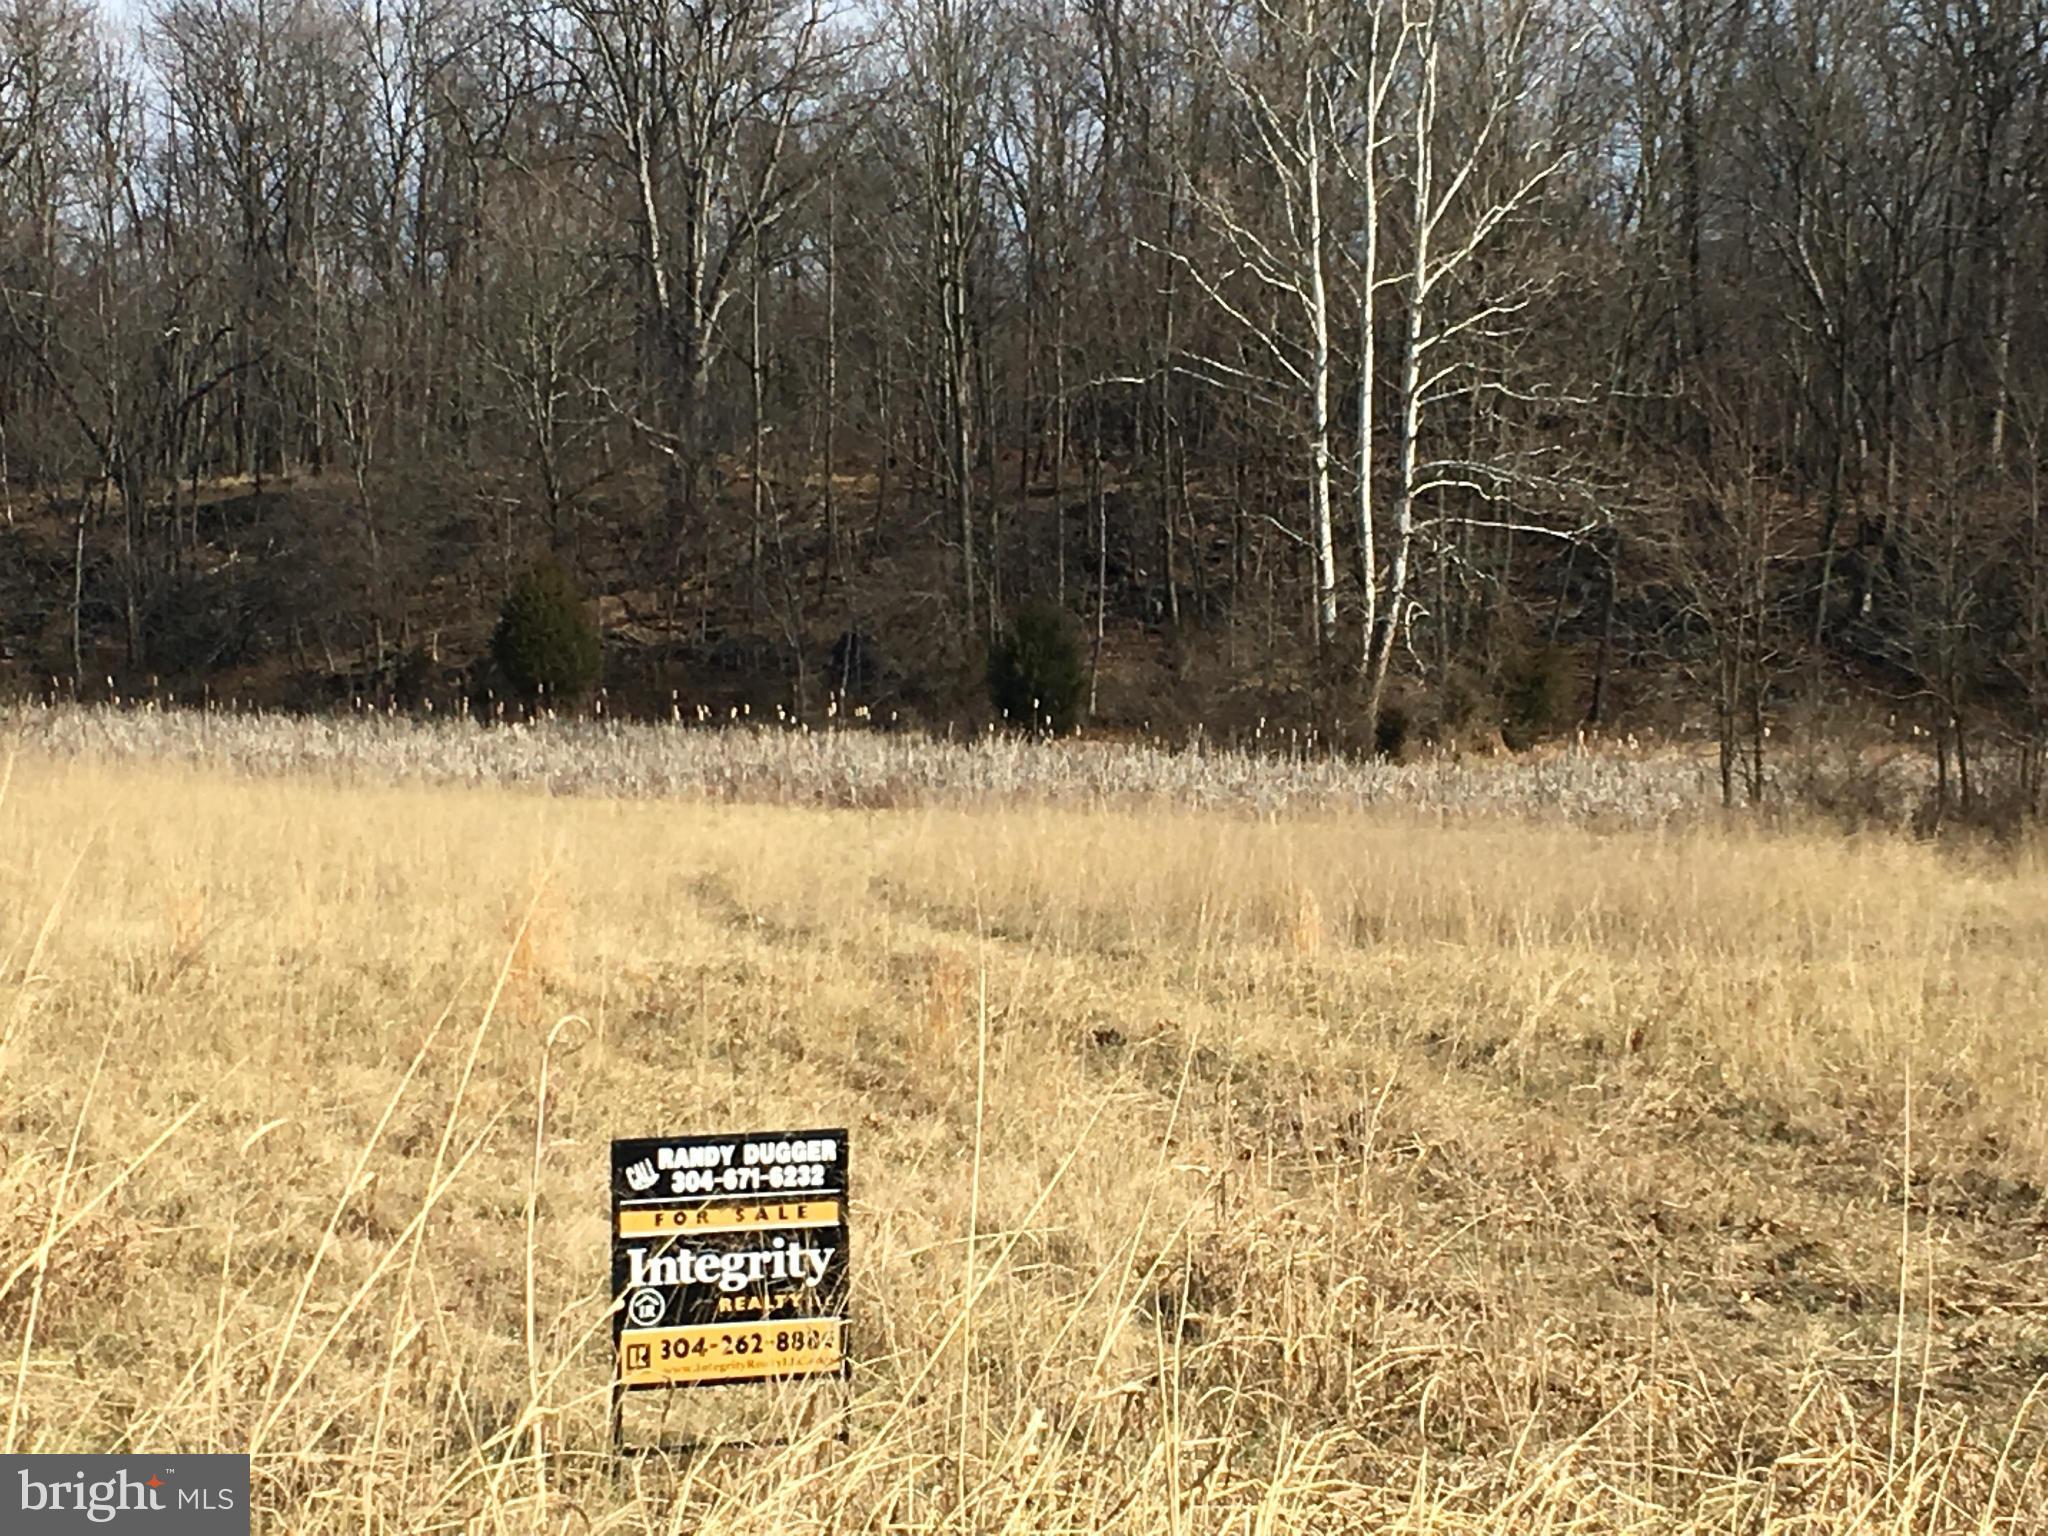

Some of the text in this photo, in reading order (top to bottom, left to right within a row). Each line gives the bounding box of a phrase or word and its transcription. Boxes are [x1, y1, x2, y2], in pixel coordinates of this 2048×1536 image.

[658, 1139, 837, 1170] RANDY DUGGER
[671, 1164, 825, 1193] 304-671-6232
[655, 1205, 808, 1227] FOR SALE
[627, 1237, 835, 1291] Integrity
[719, 1293, 803, 1312] REALTY
